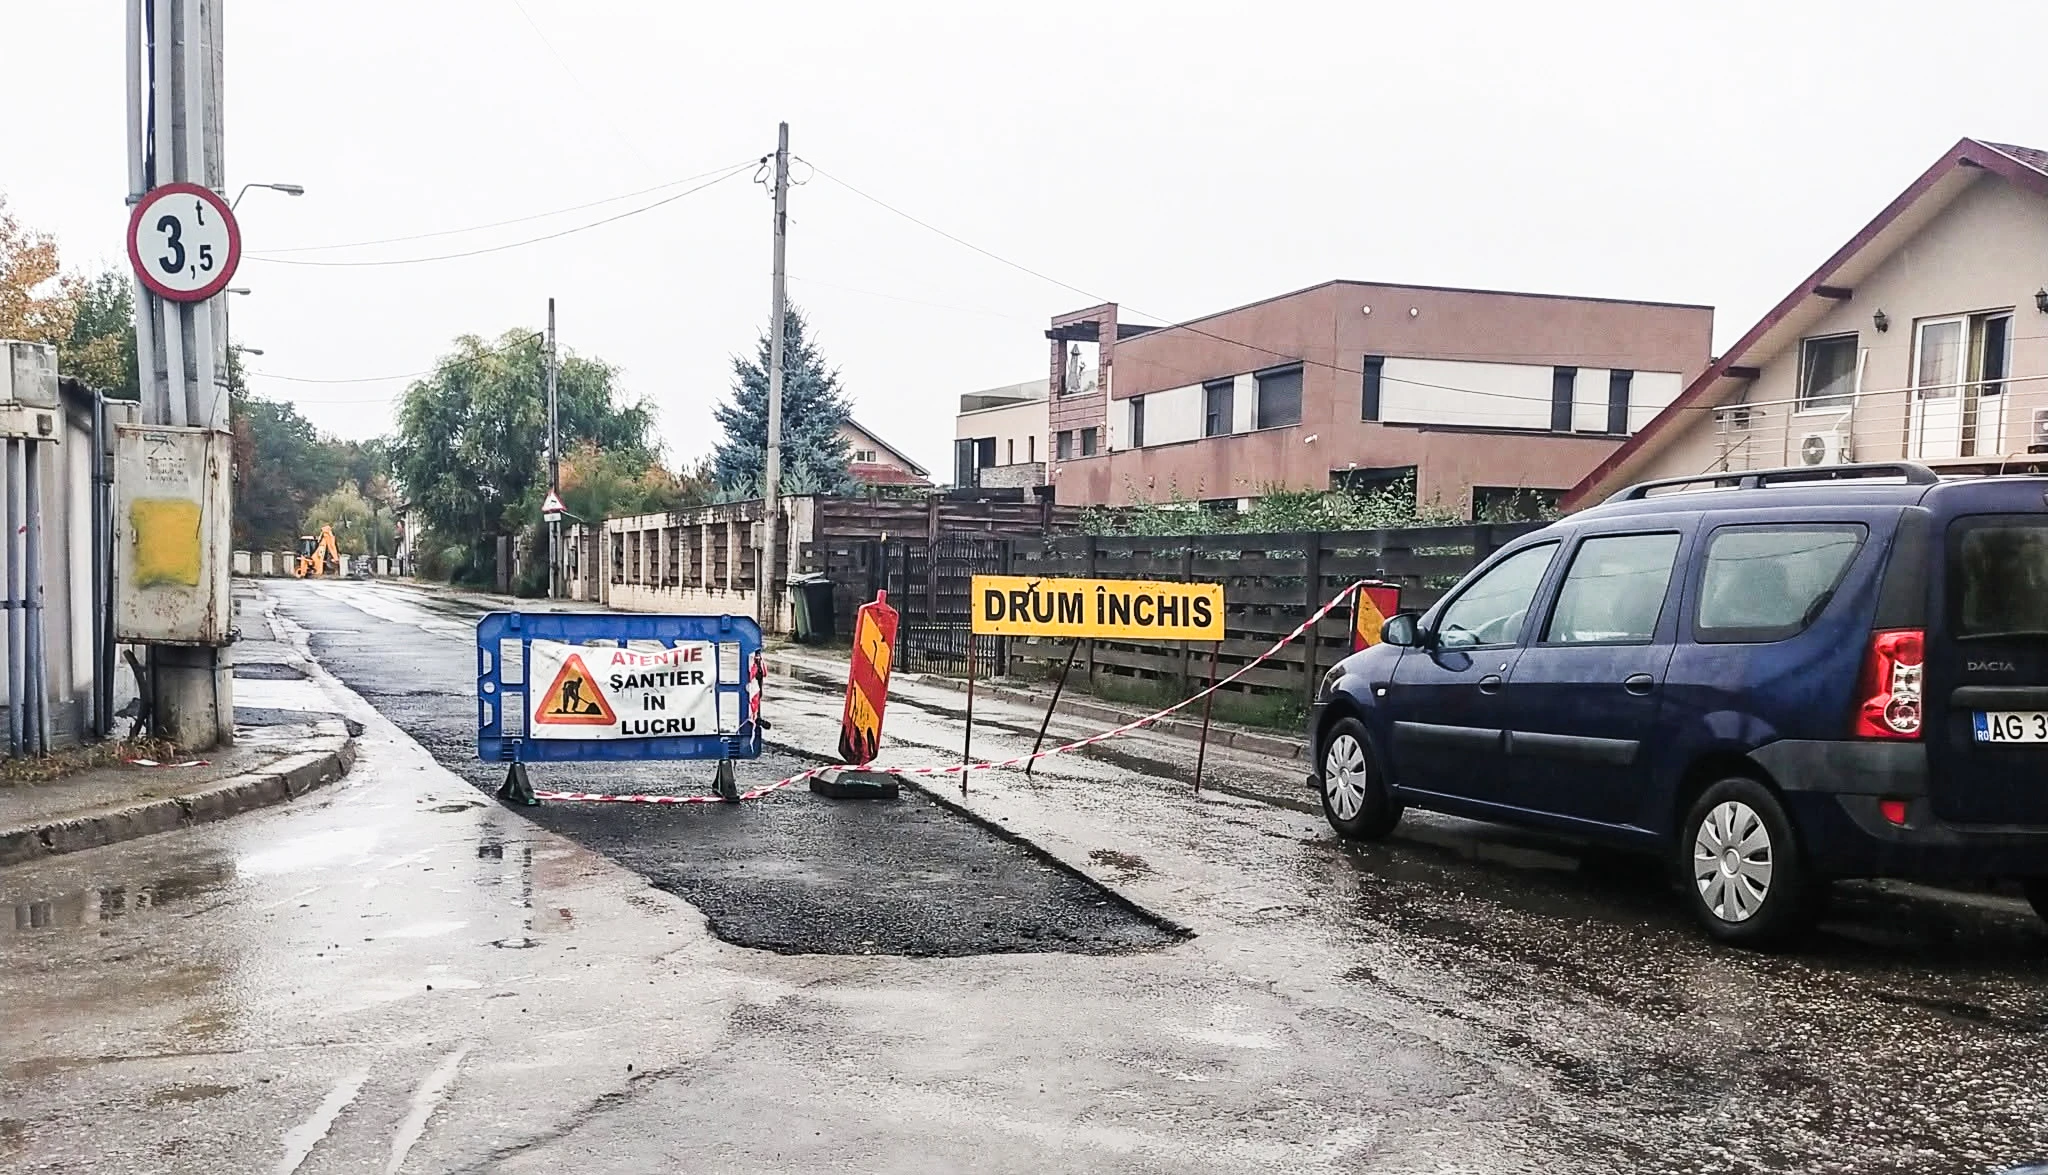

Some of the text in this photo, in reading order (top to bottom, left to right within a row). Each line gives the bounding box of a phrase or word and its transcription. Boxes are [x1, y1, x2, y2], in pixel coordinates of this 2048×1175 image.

[195, 200, 205, 226] t
[984, 585, 1213, 628] DRUM ÎNCHIS
[1967, 661, 2016, 671] DACIA
[643, 692, 666, 711] ÎN
[621, 717, 696, 735] LUCRU
[1977, 729, 1989, 741] RO
[1992, 714, 2048, 740] AG 3
